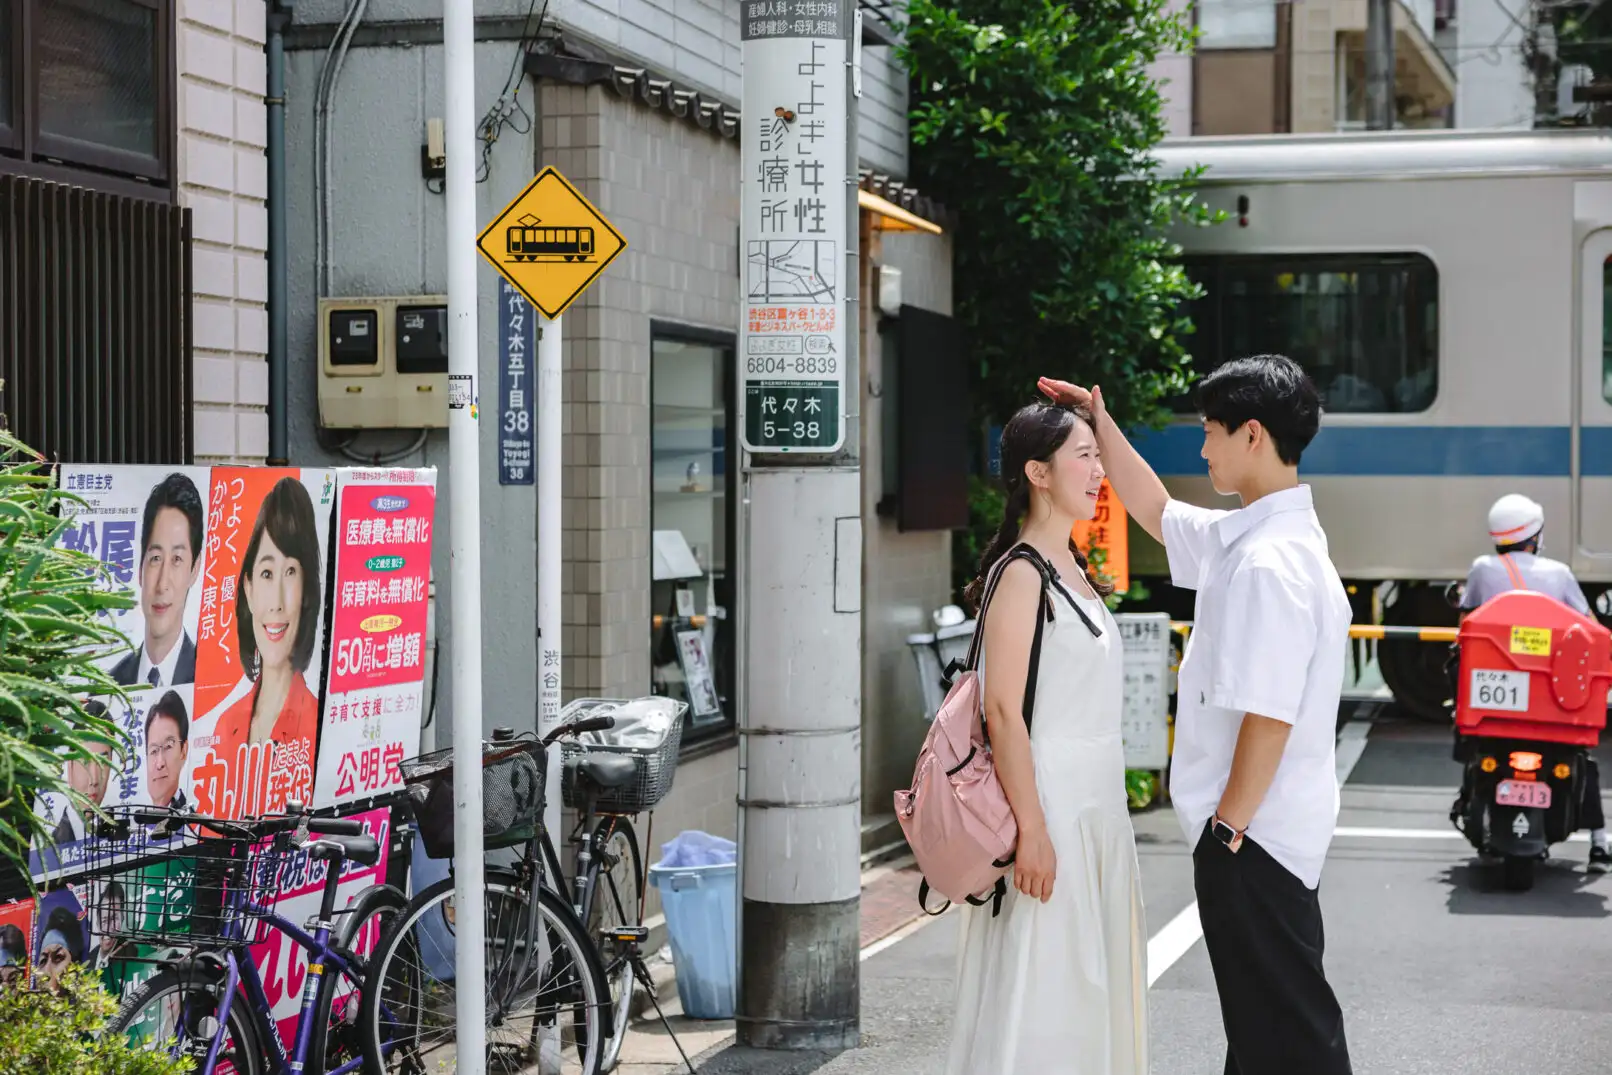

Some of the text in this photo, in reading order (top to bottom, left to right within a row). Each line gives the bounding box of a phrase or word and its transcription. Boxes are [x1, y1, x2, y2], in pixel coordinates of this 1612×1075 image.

[757, 117, 790, 233] 診療所
[508, 295, 525, 408] 代々木五丁目
[747, 357, 837, 374] 6804-8839
[761, 396, 822, 415] 代々木
[504, 410, 529, 433] 38
[764, 421, 820, 439] 5-38
[67, 473, 113, 490] 立憲民主党
[510, 467, 524, 479] 38
[346, 516, 429, 545] 医療費を無償化
[201, 480, 227, 640] かがやく東京
[341, 576, 425, 608] 保育料を無償化
[336, 631, 421, 677] 50万円に増額
[543, 650, 559, 688] 渋谷
[1476, 671, 1507, 681] 代々木
[1479, 685, 1518, 706] 601
[192, 739, 274, 821] 丸川
[267, 763, 313, 815] 珠代
[335, 741, 404, 797] 公明党
